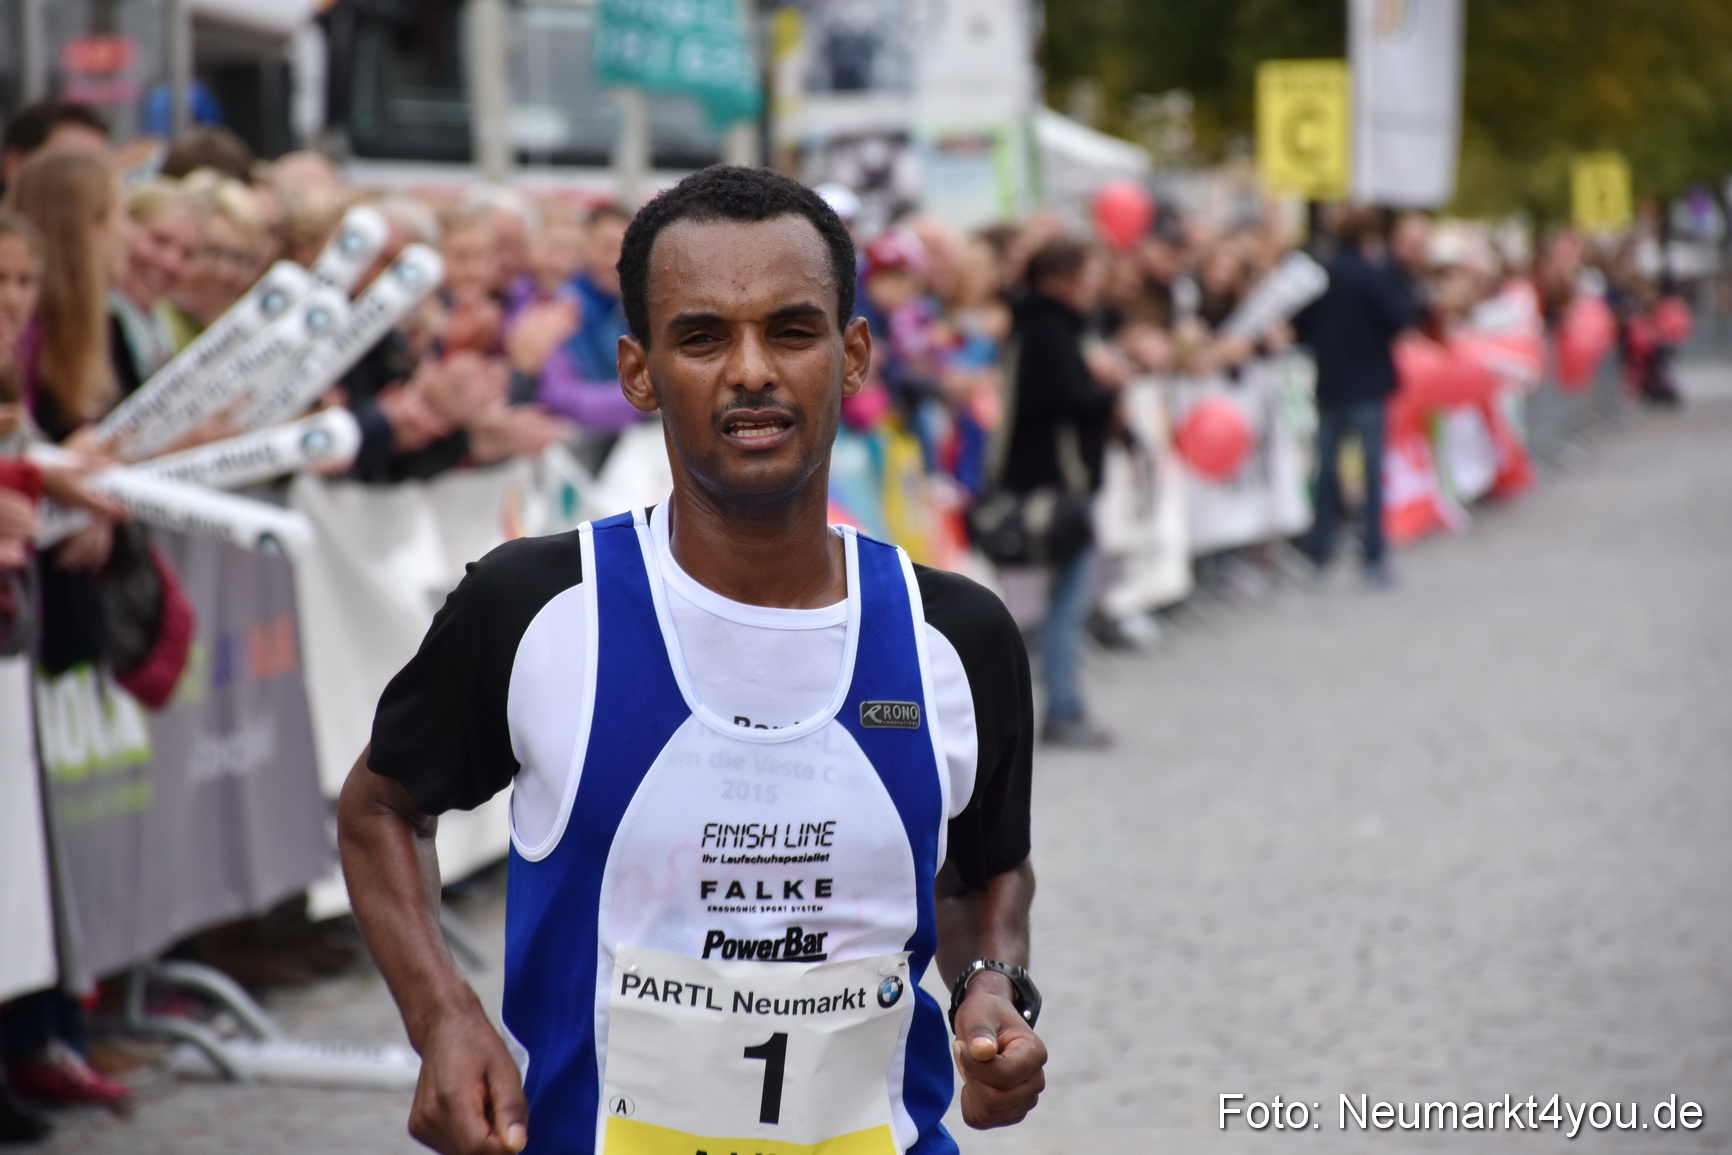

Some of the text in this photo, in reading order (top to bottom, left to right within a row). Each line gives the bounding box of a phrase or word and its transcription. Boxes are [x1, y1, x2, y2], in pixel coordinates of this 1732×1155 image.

[721, 779, 779, 805] 2015
[701, 821, 836, 848] FINISH LINE
[702, 853, 830, 865] Ihr Laufschuhspezialist
[700, 878, 833, 900] FALKE
[701, 926, 828, 960] PowerBar
[620, 973, 866, 1016] PARTL Neumarkt
[743, 1032, 788, 1125] 1
